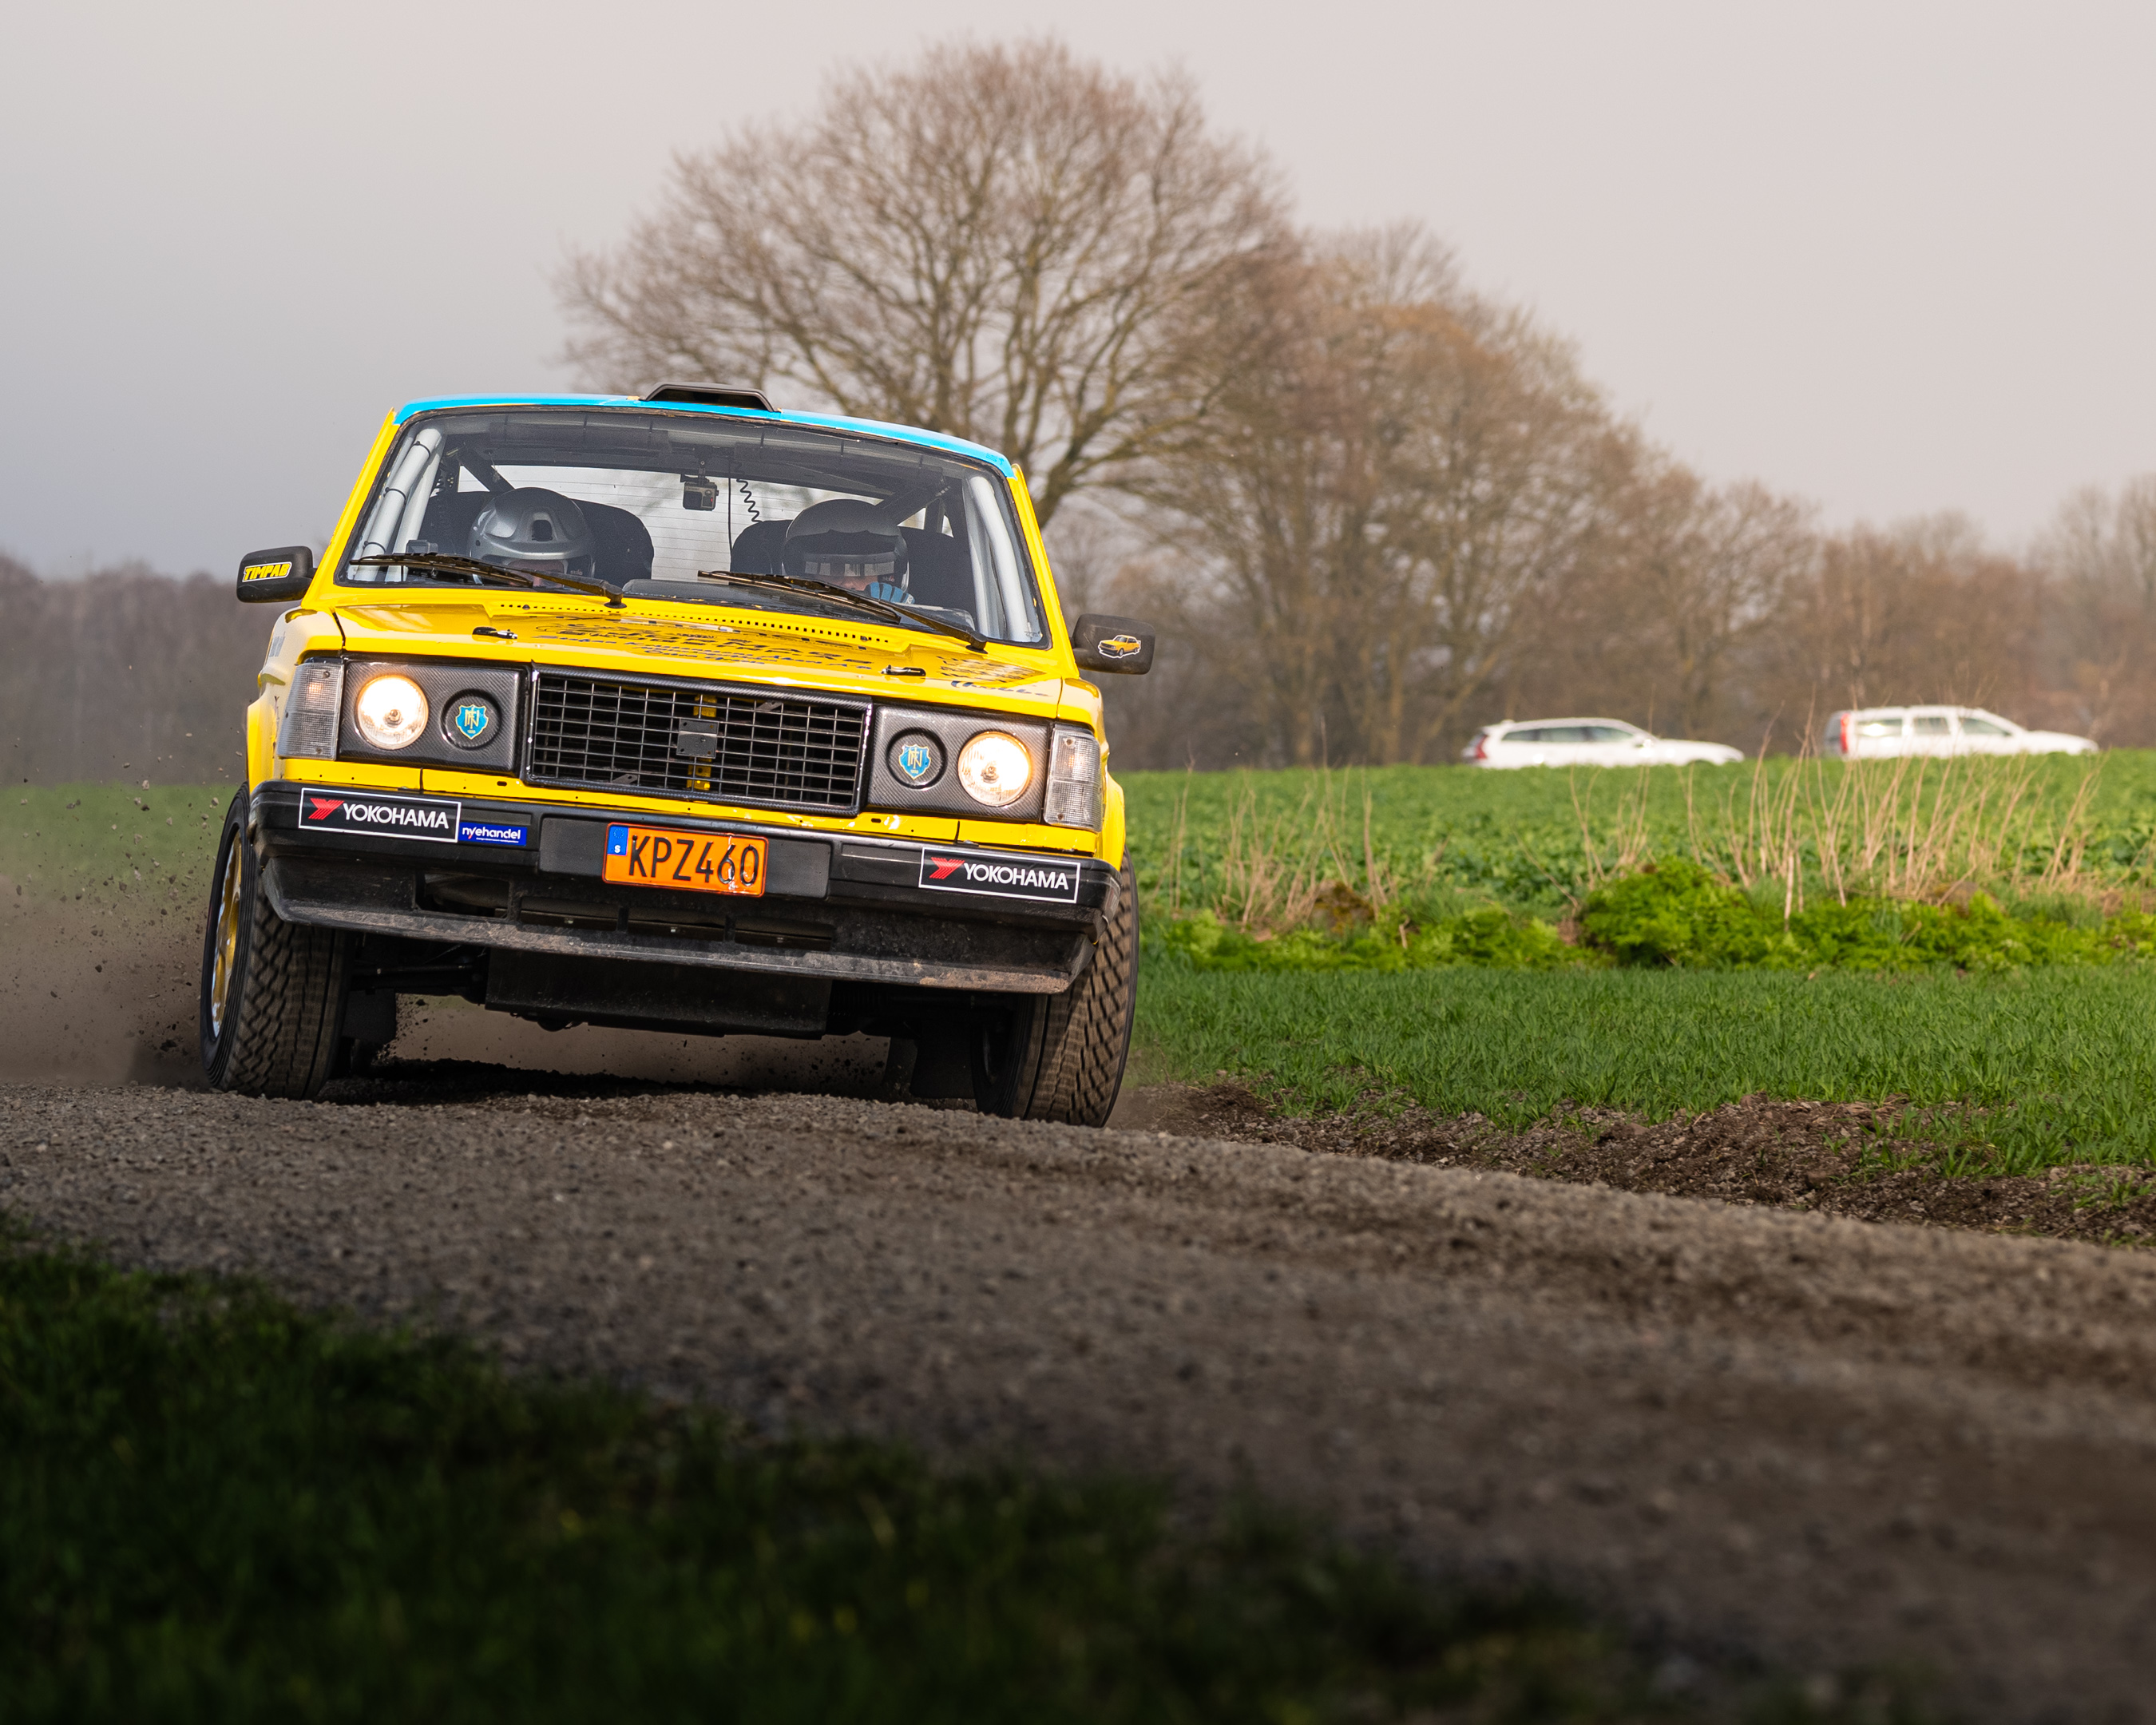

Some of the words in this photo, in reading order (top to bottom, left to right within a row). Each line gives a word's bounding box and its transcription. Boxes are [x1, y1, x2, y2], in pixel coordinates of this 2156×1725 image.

[244, 563, 291, 581] TIMPAB
[343, 803, 449, 829] YOKOHAMA
[462, 827, 521, 839] nyehandel
[614, 844, 621, 854] S
[628, 835, 759, 886] KPZ460
[964, 862, 1069, 890] YOKOHAMA
